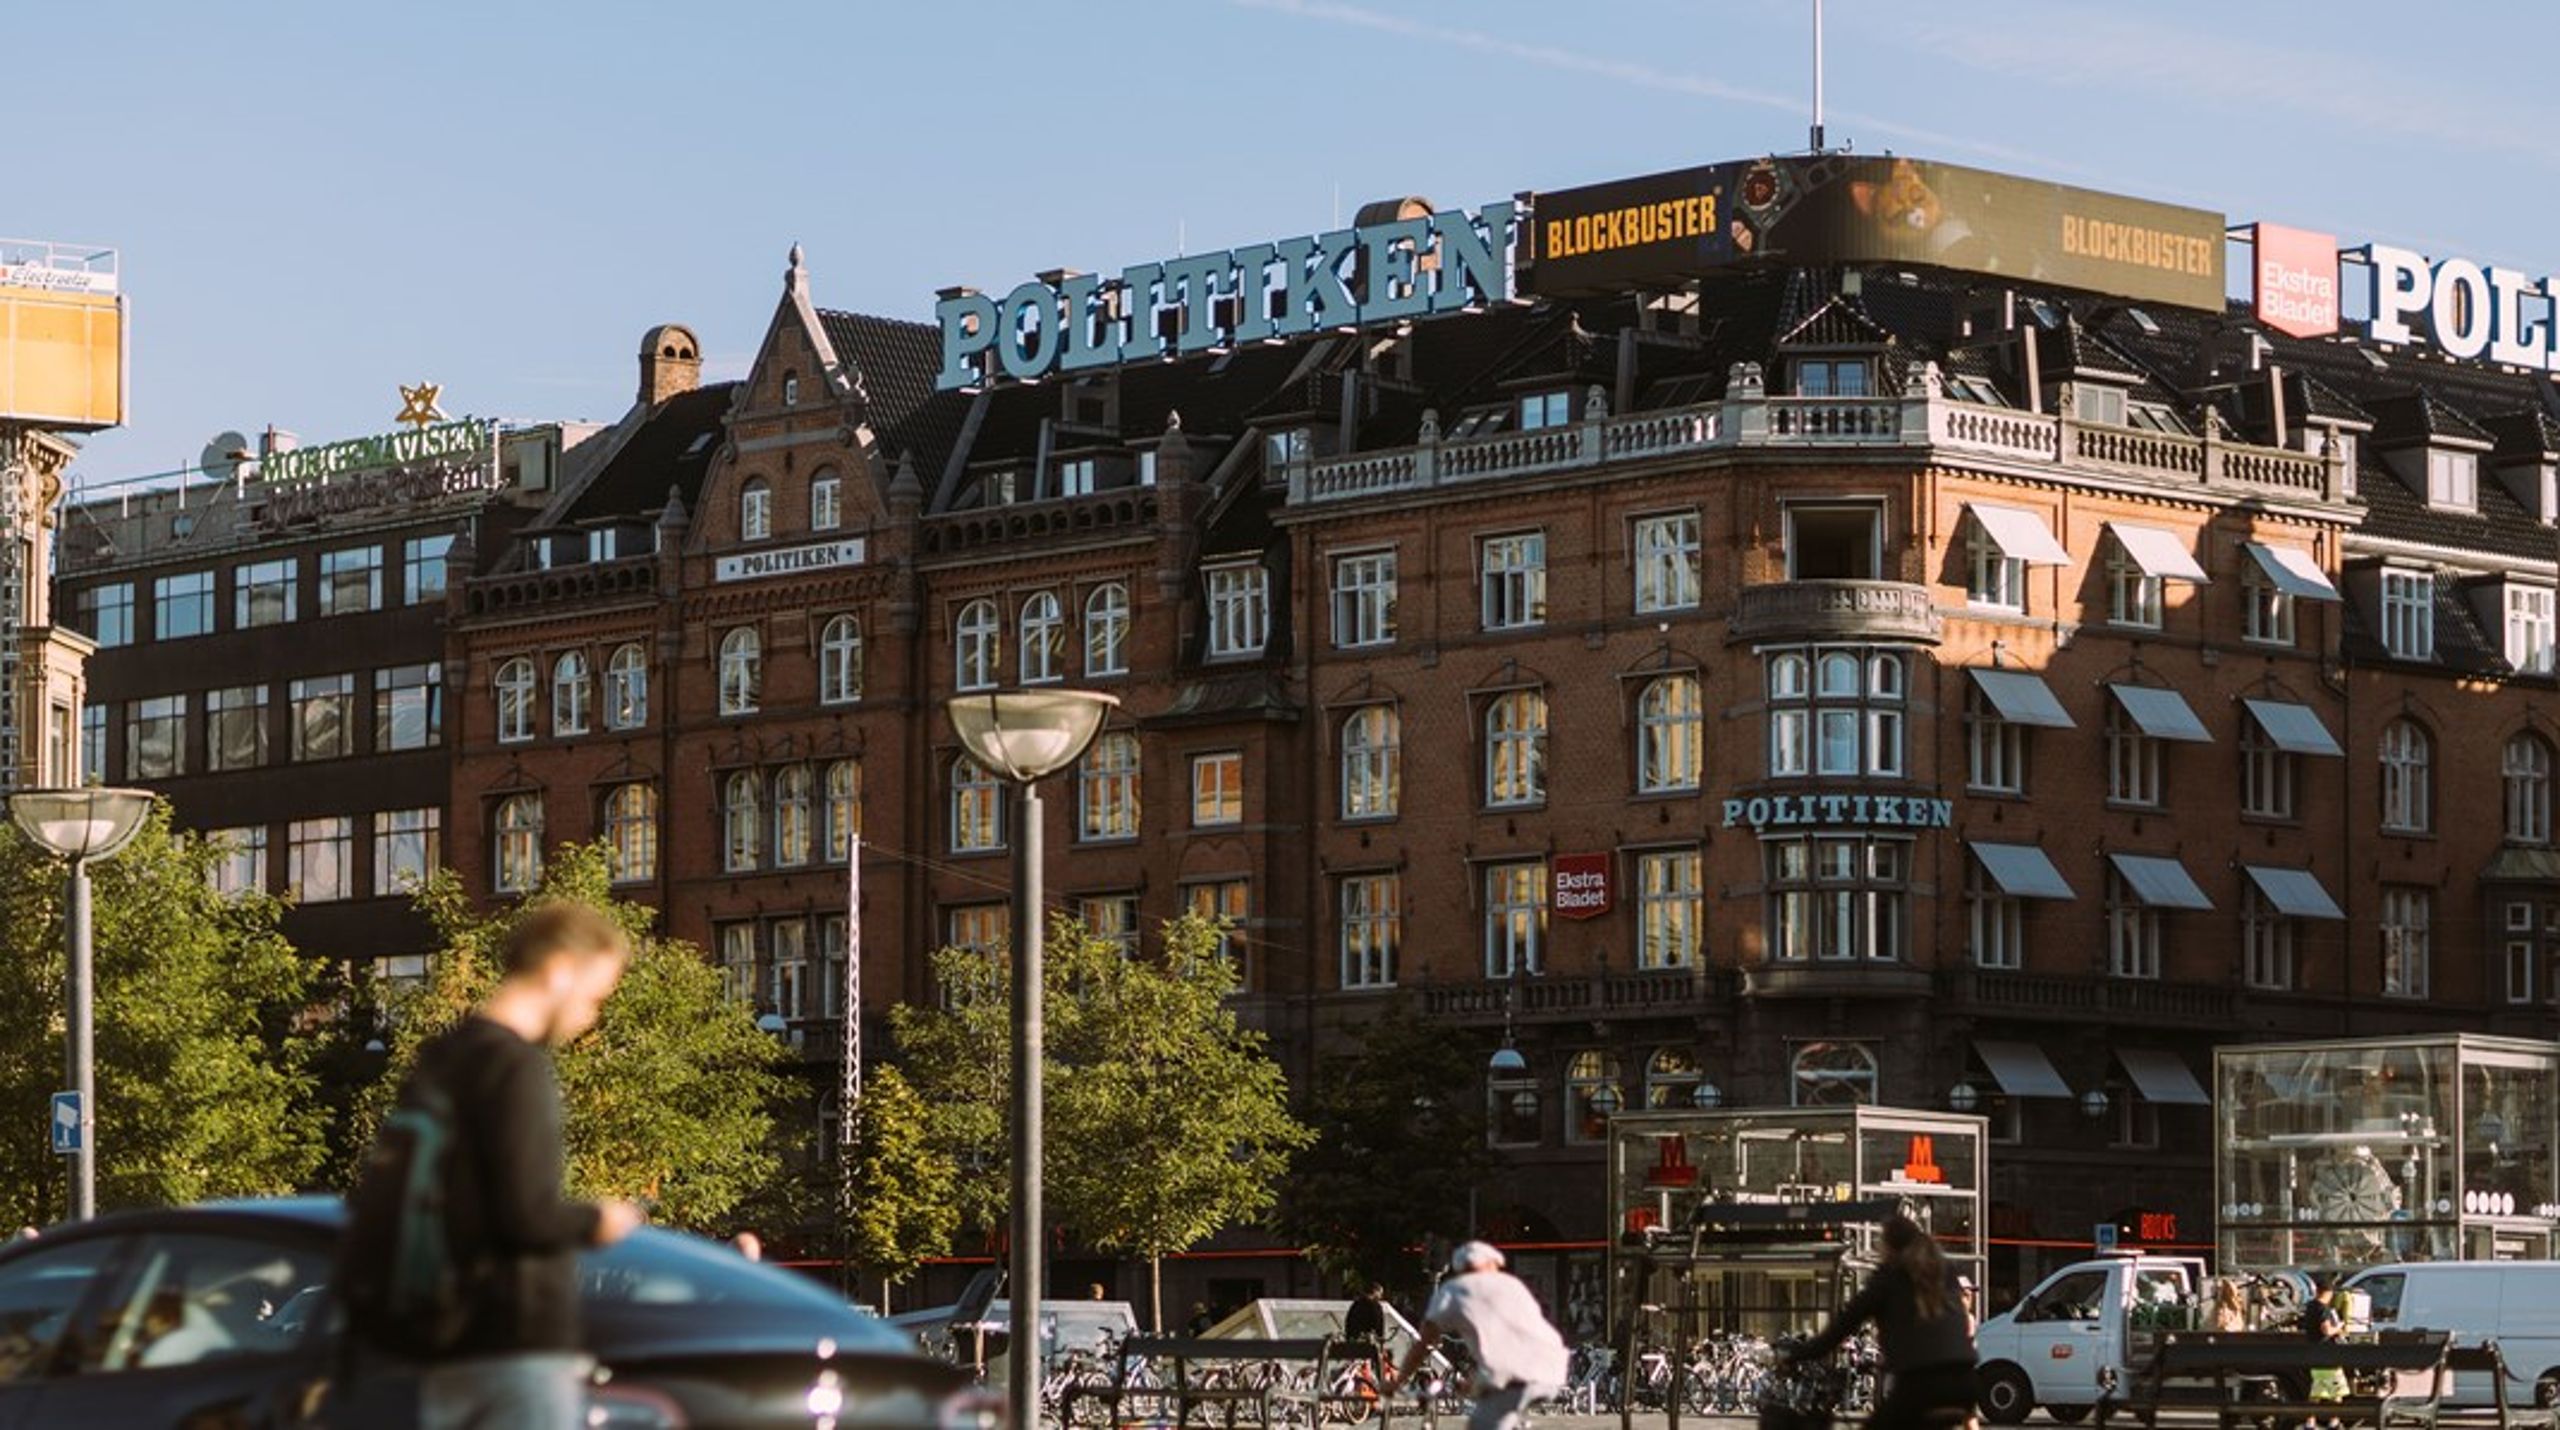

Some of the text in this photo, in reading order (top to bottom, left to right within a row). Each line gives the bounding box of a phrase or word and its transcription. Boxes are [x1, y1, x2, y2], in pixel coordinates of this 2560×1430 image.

[1547, 194, 1717, 260] BLOCKBUSTER
[2062, 213, 2213, 277] BLOCKBUSTER
[936, 200, 1518, 393] POLITIKEN
[2263, 261, 2333, 298] Ekstra
[2263, 290, 2333, 327] Bladet
[741, 545, 841, 575] POLITIKEN
[1722, 795, 1953, 828] POLITIKEN
[1557, 872, 1605, 890] Ekstra
[1557, 889, 1605, 908] Bladet
